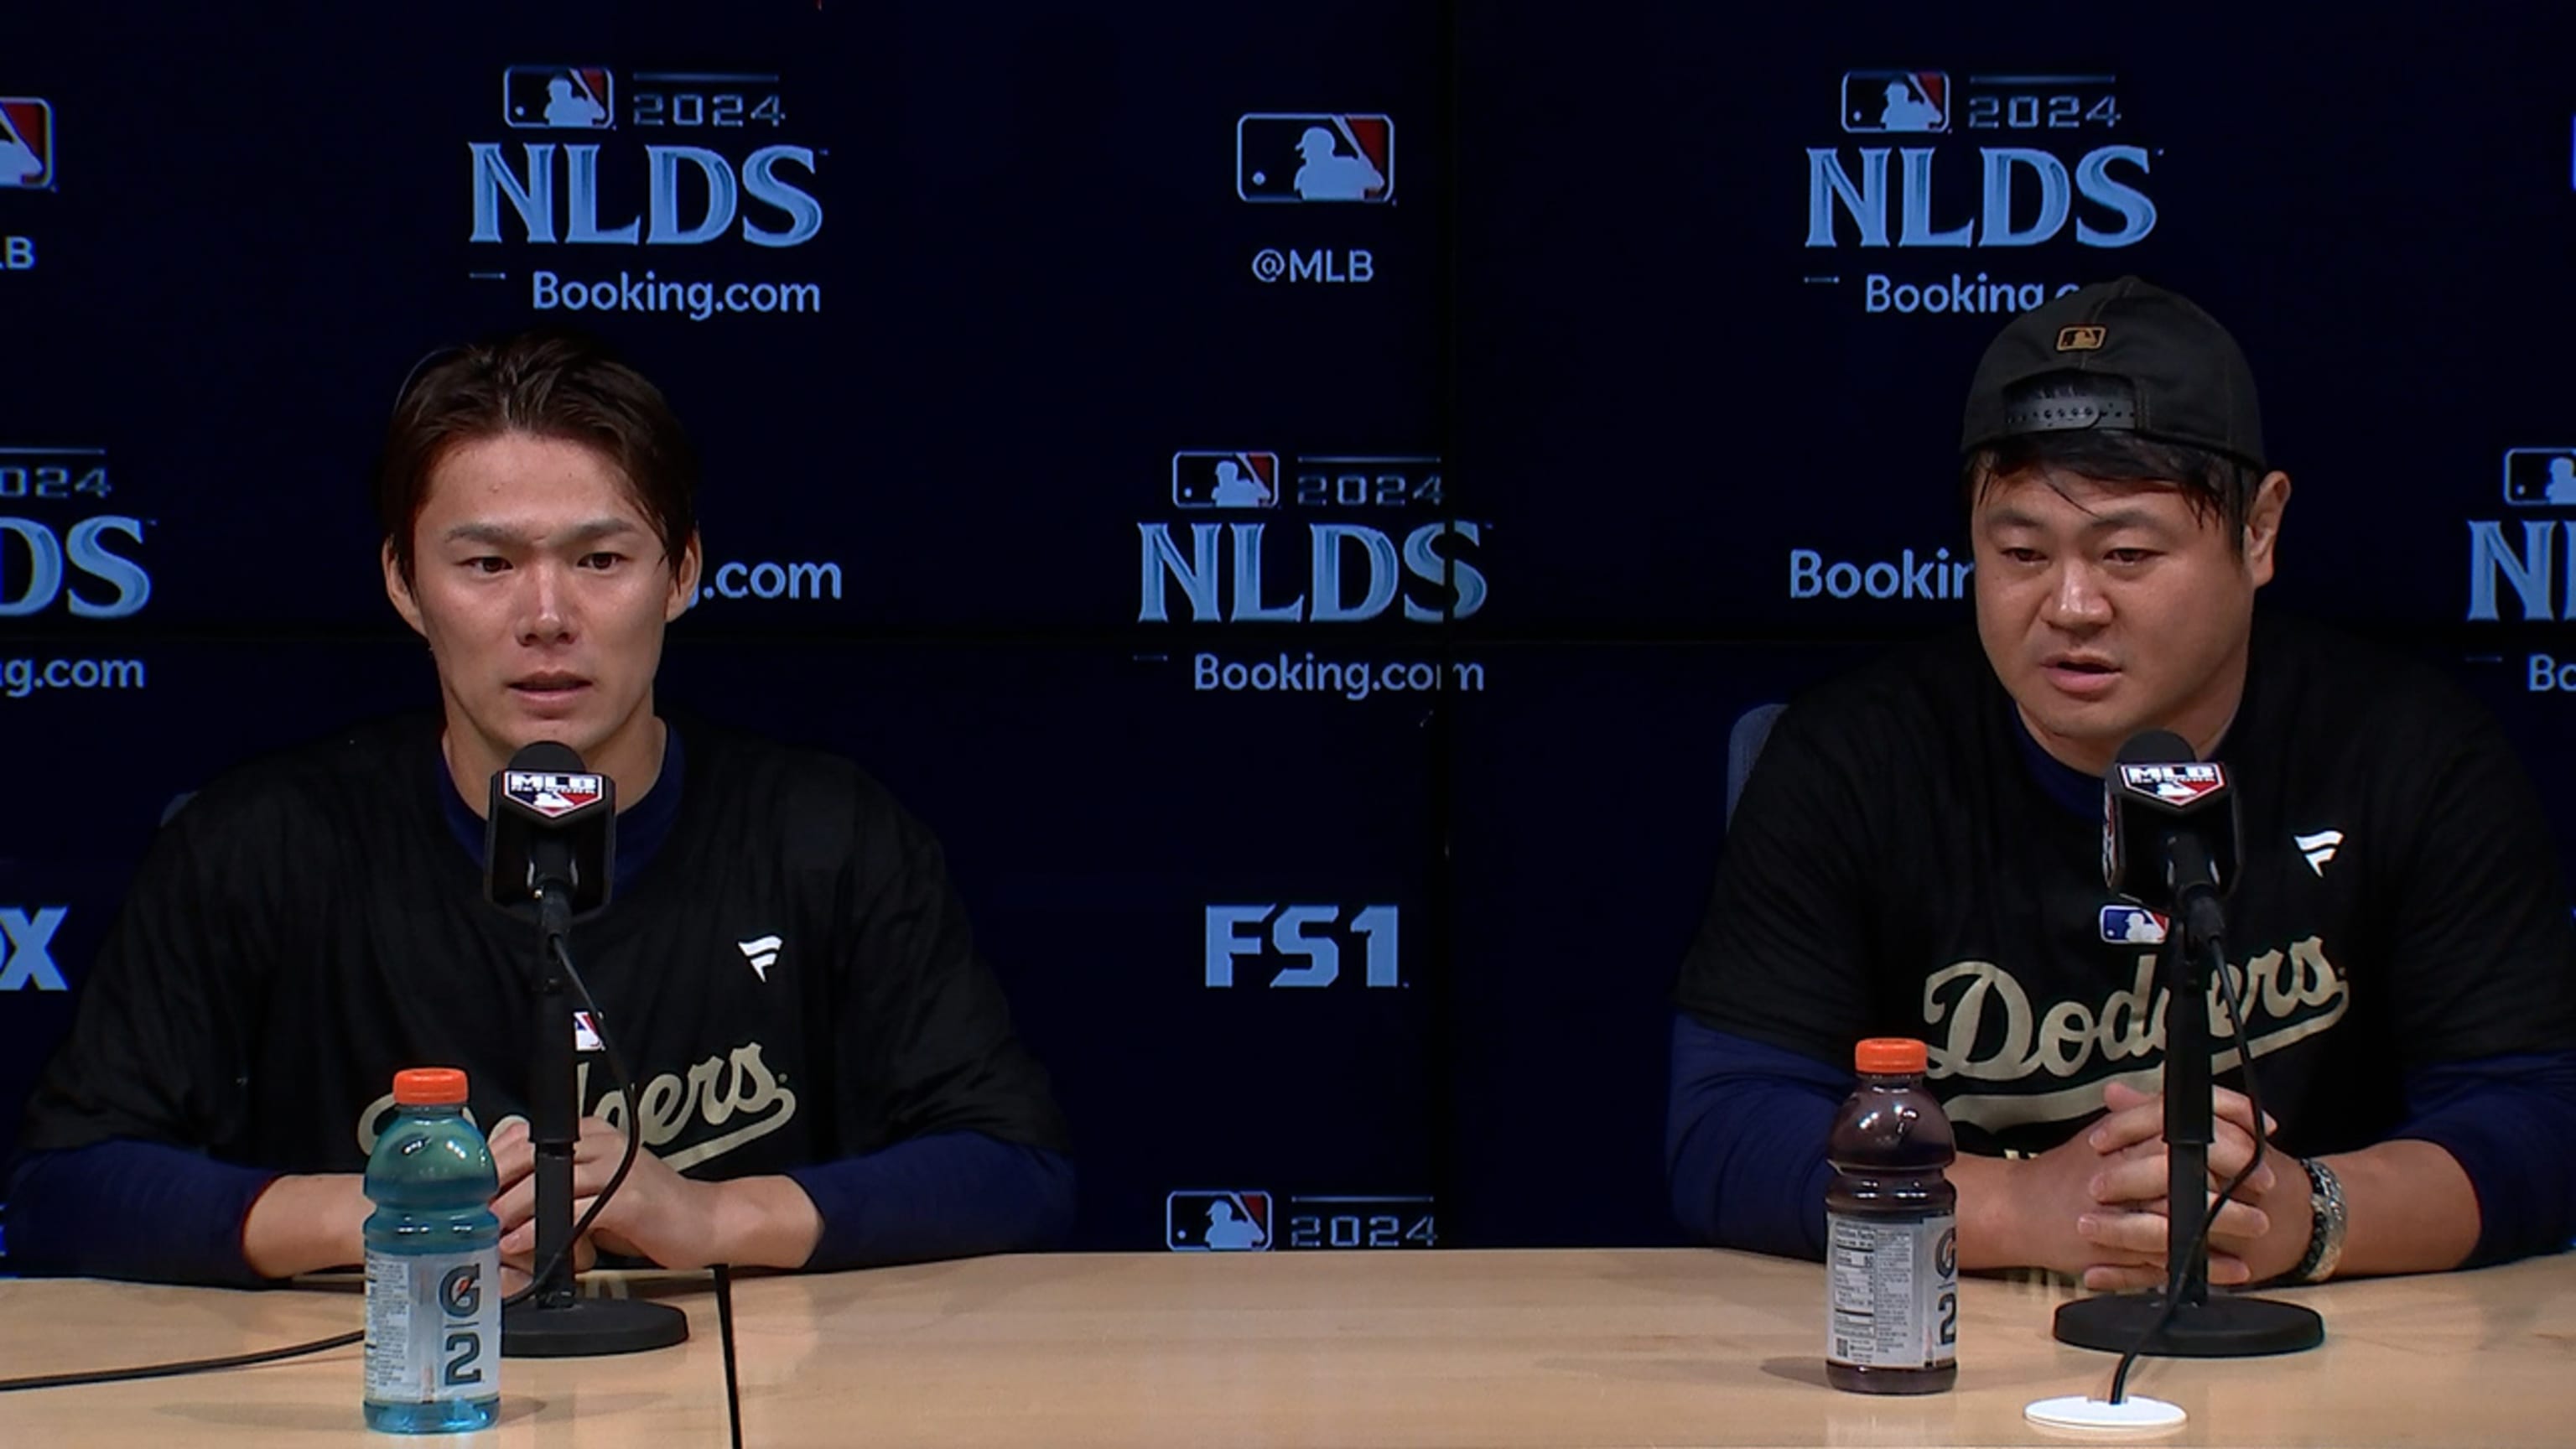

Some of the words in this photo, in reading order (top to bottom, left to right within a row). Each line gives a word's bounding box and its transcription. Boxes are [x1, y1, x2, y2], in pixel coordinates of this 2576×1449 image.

[633, 94, 786, 127] 2024
[1968, 96, 2122, 128] 2024
[468, 142, 823, 247] NLDS
[1805, 144, 2158, 247] NLDS
[1252, 248, 1374, 283] @MLB
[532, 270, 821, 321] Booking.com
[0, 466, 112, 498] 024
[1297, 475, 1443, 506] 2024
[0, 515, 151, 618] DS
[1137, 520, 1488, 623] NLDS
[1205, 903, 1399, 988] FS1
[1291, 1216, 1437, 1248] 2024
[444, 1332, 482, 1386] 2
